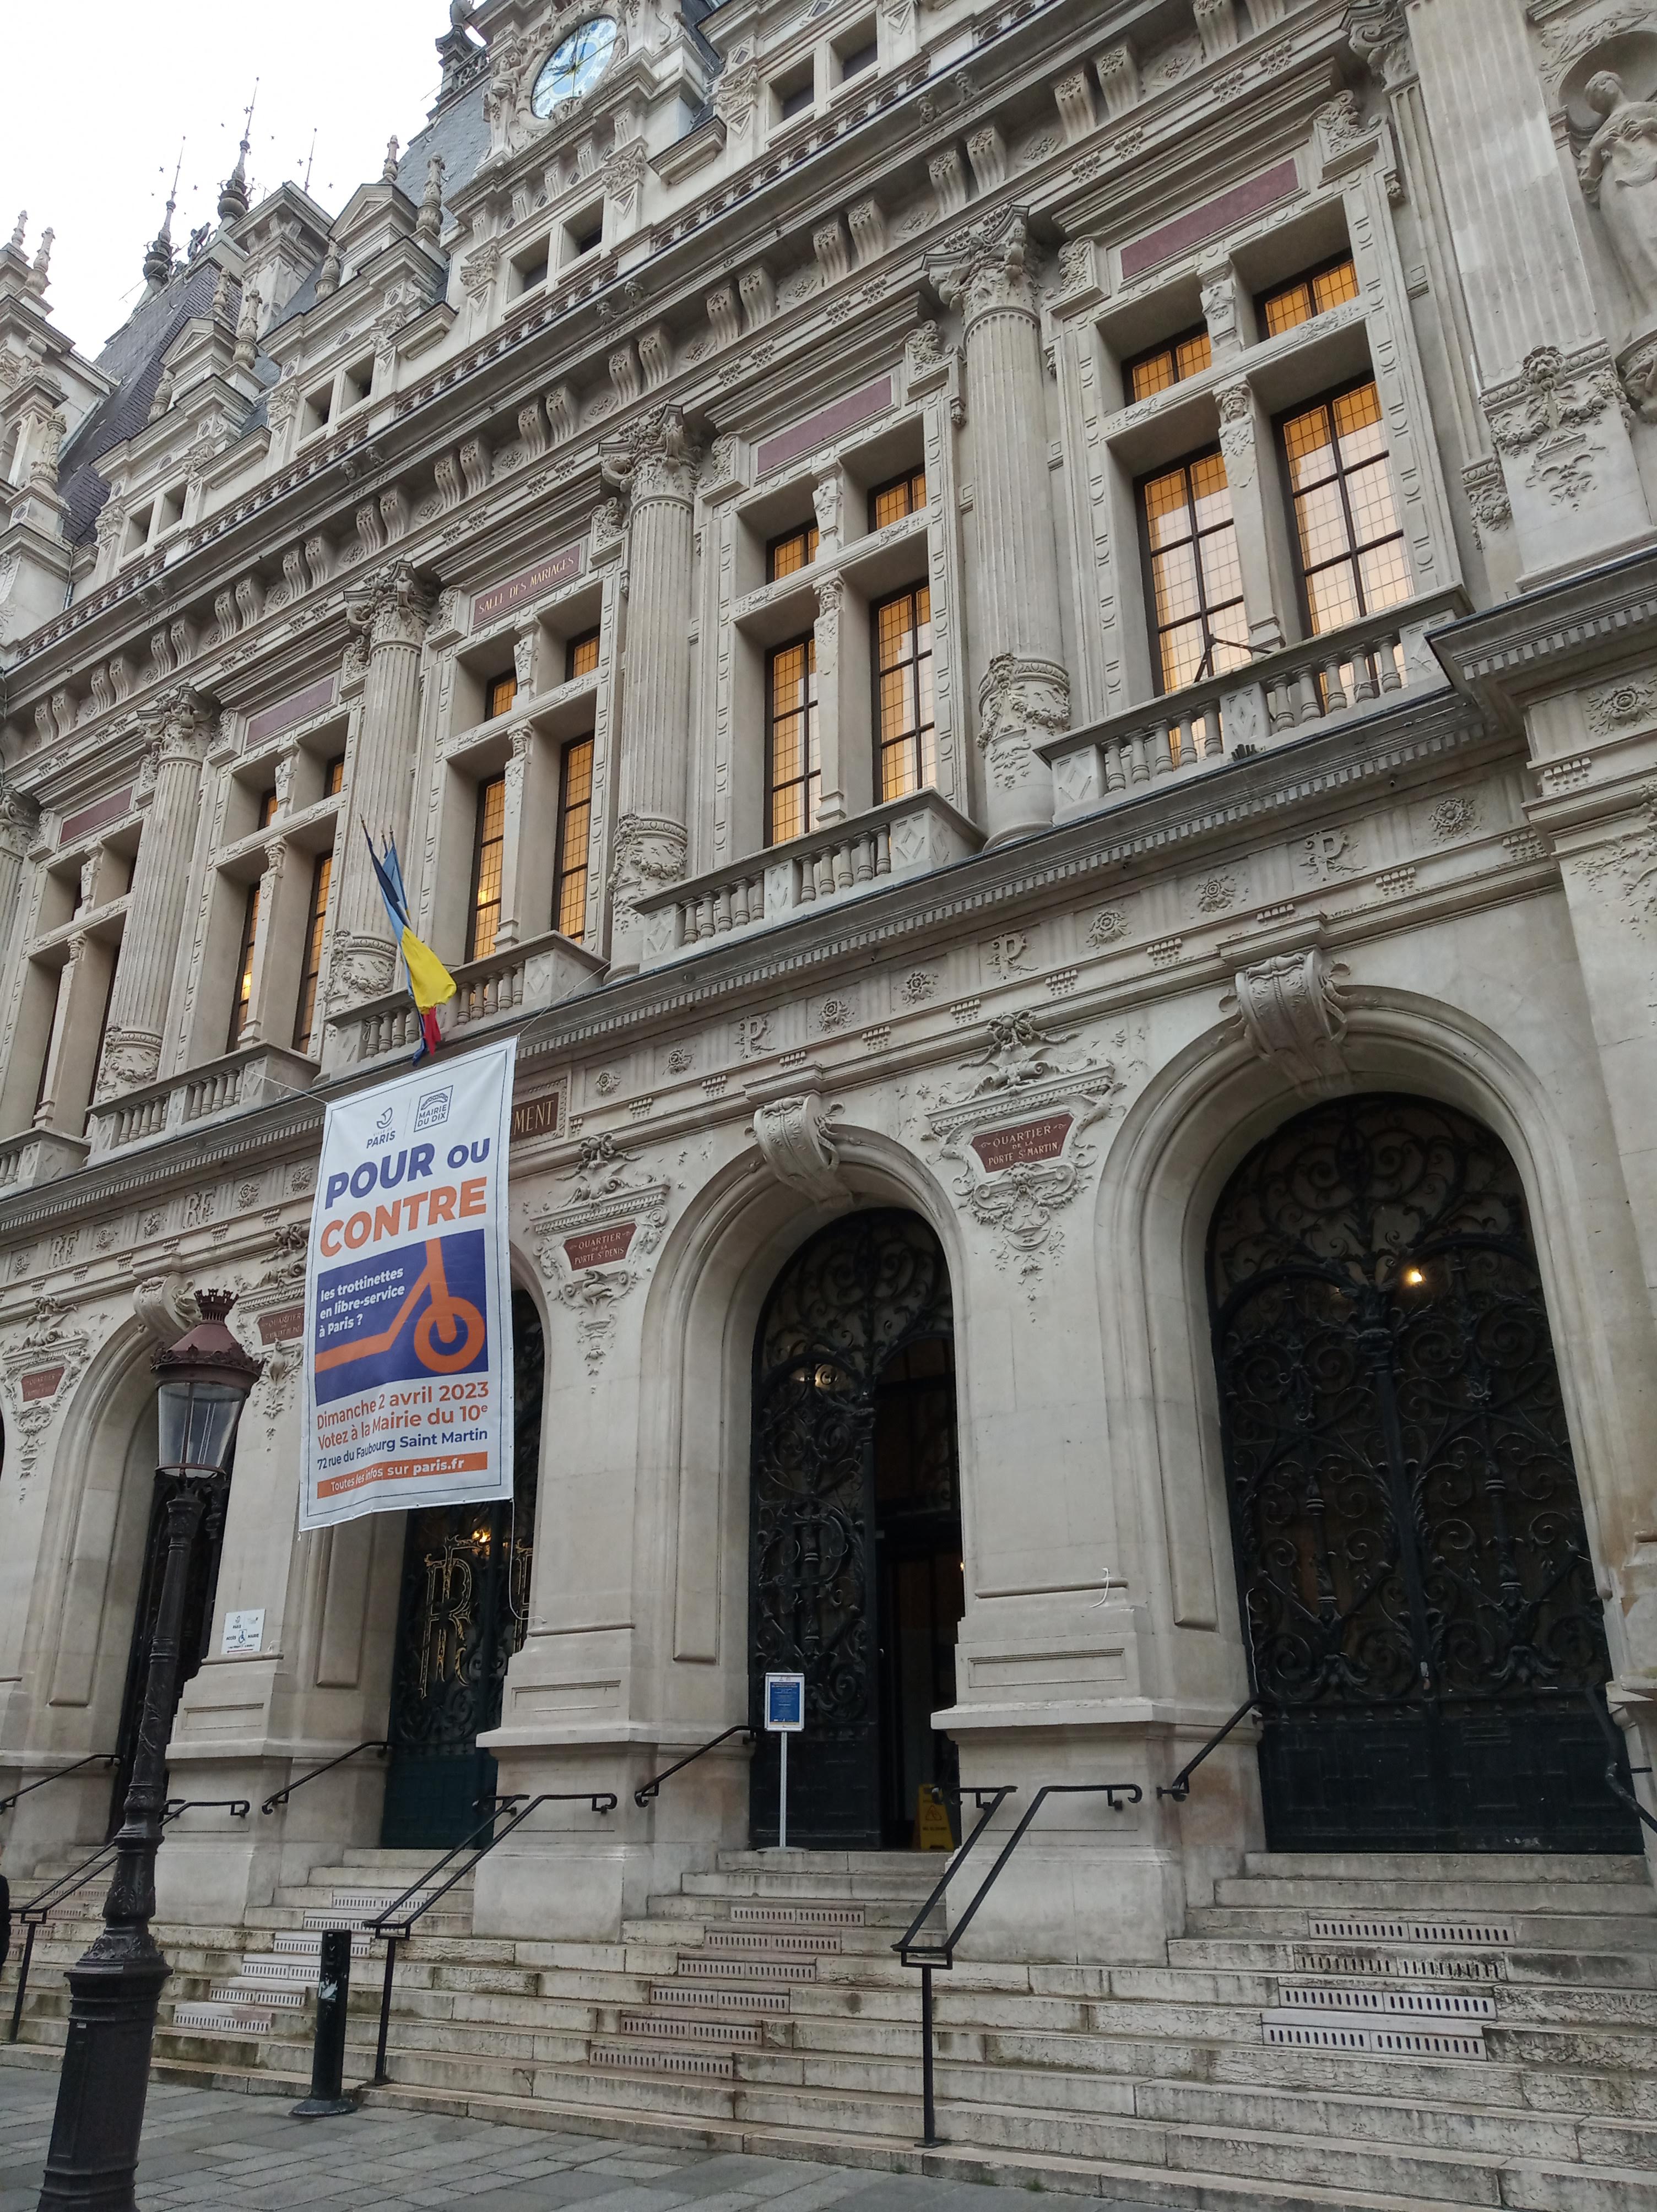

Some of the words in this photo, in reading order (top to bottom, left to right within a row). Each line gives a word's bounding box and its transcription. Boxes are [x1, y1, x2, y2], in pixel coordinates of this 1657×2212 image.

[479, 595, 503, 615] SALLE
[509, 583, 527, 600] DES
[530, 556, 574, 588] MARIAGES
[417, 1119, 430, 1127] DU
[431, 1113, 446, 1123] DIX
[419, 1104, 447, 1119] MAIRIE
[511, 1100, 554, 1136] MENT
[366, 1130, 396, 1149] PARIS
[993, 1125, 1051, 1147] QUARTIER
[988, 1153, 1014, 1166] PORTE
[1027, 1141, 1058, 1156] MARTIN
[325, 1143, 435, 1210] POUR
[447, 1138, 490, 1169] OU
[320, 1177, 487, 1257] CONTRE
[575, 1254, 594, 1265] PORTE
[605, 1247, 624, 1258] DENIS
[578, 1233, 621, 1250] QUARTIER
[321, 1287, 335, 1302] les
[337, 1267, 404, 1295] trottinettes
[320, 1306, 332, 1320] en
[334, 1284, 405, 1314] libre-service
[319, 1325, 325, 1338] à
[328, 1317, 354, 1335] Paris
[356, 1314, 363, 1325] ?
[317, 1399, 376, 1430] Dimanche
[378, 1394, 385, 1410] 2
[389, 1386, 432, 1407] avril
[439, 1381, 489, 1402] 2023
[318, 1427, 349, 1450] Votez
[351, 1424, 358, 1440] à
[361, 1419, 370, 1437] la
[372, 1411, 421, 1433] Mairie
[427, 1406, 454, 1425] du
[317, 1459, 327, 1470] 72
[328, 1454, 342, 1466] rue
[343, 1450, 355, 1463] du
[356, 1438, 396, 1460] Faubourg
[400, 1433, 437, 1449] Saint
[441, 1428, 488, 1445] Martin
[331, 1477, 354, 1492] Toutes
[356, 1472, 365, 1485] les
[365, 1467, 383, 1482] infos
[387, 1463, 409, 1476] sur
[413, 1458, 465, 1477] paris.fr
